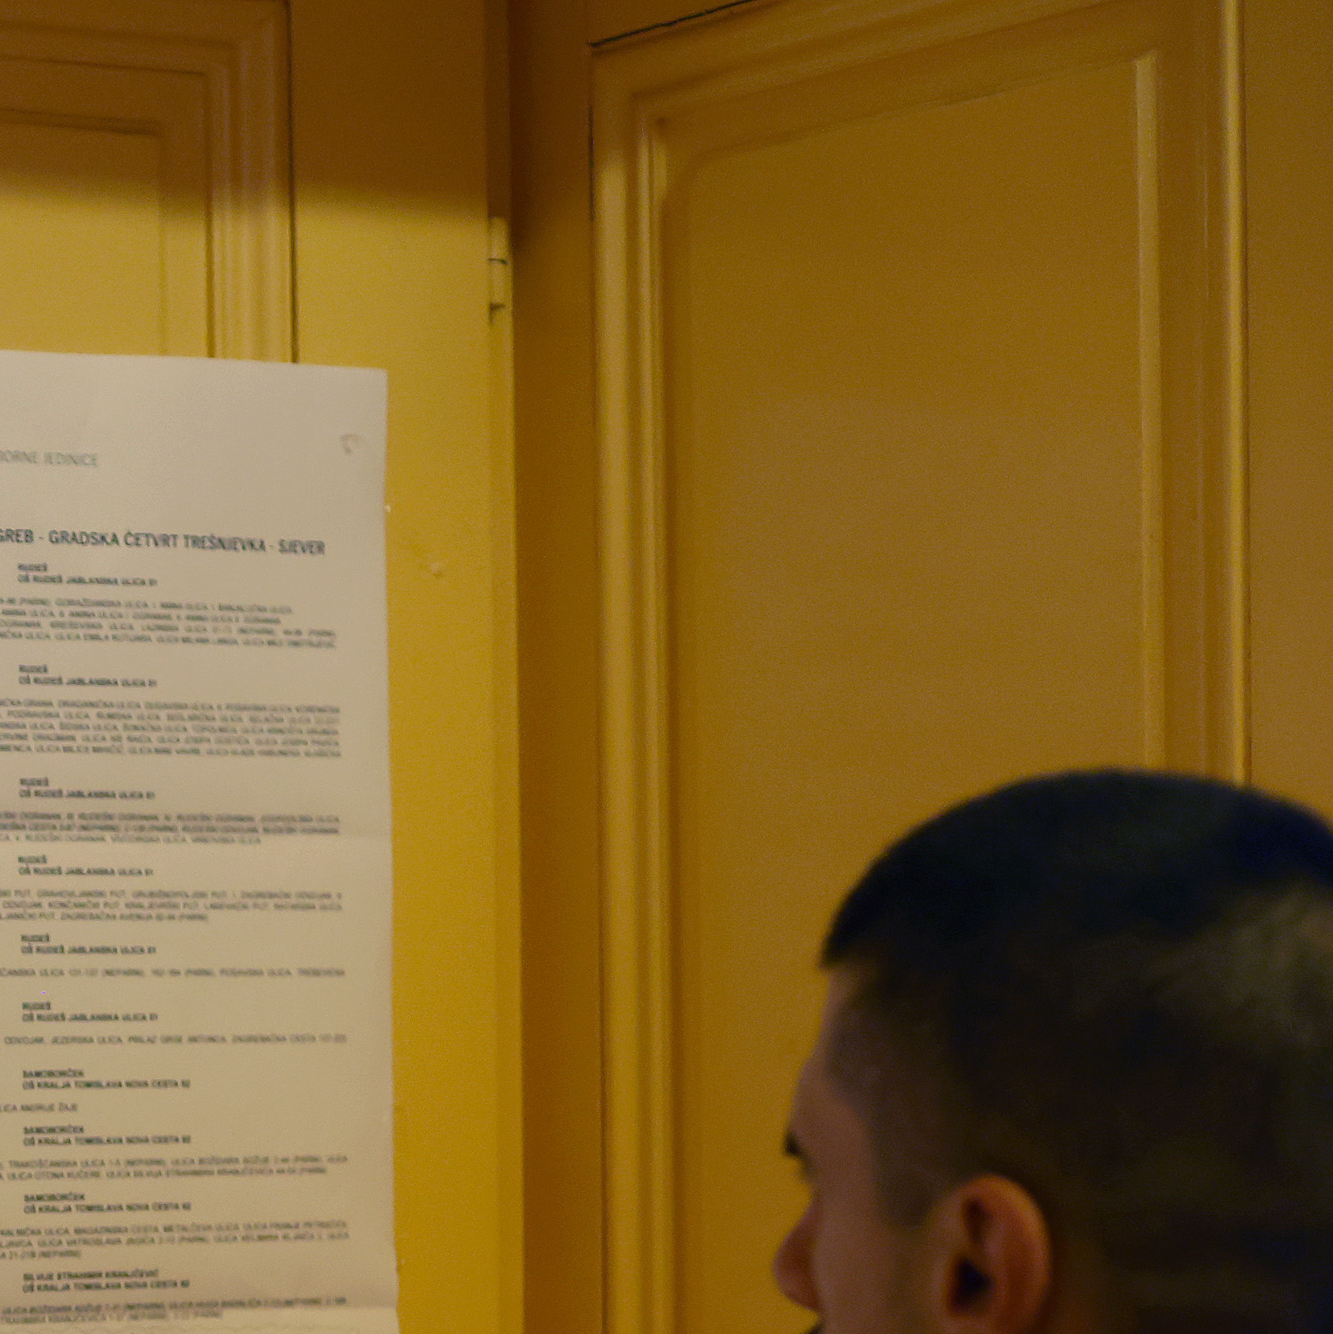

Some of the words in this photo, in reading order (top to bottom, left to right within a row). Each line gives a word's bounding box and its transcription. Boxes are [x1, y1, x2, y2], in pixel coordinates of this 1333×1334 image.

[48, 529, 119, 546] GRADSKA
[123, 531, 178, 547] ČETVRT
[182, 534, 266, 552] TREŠNJEVKA
